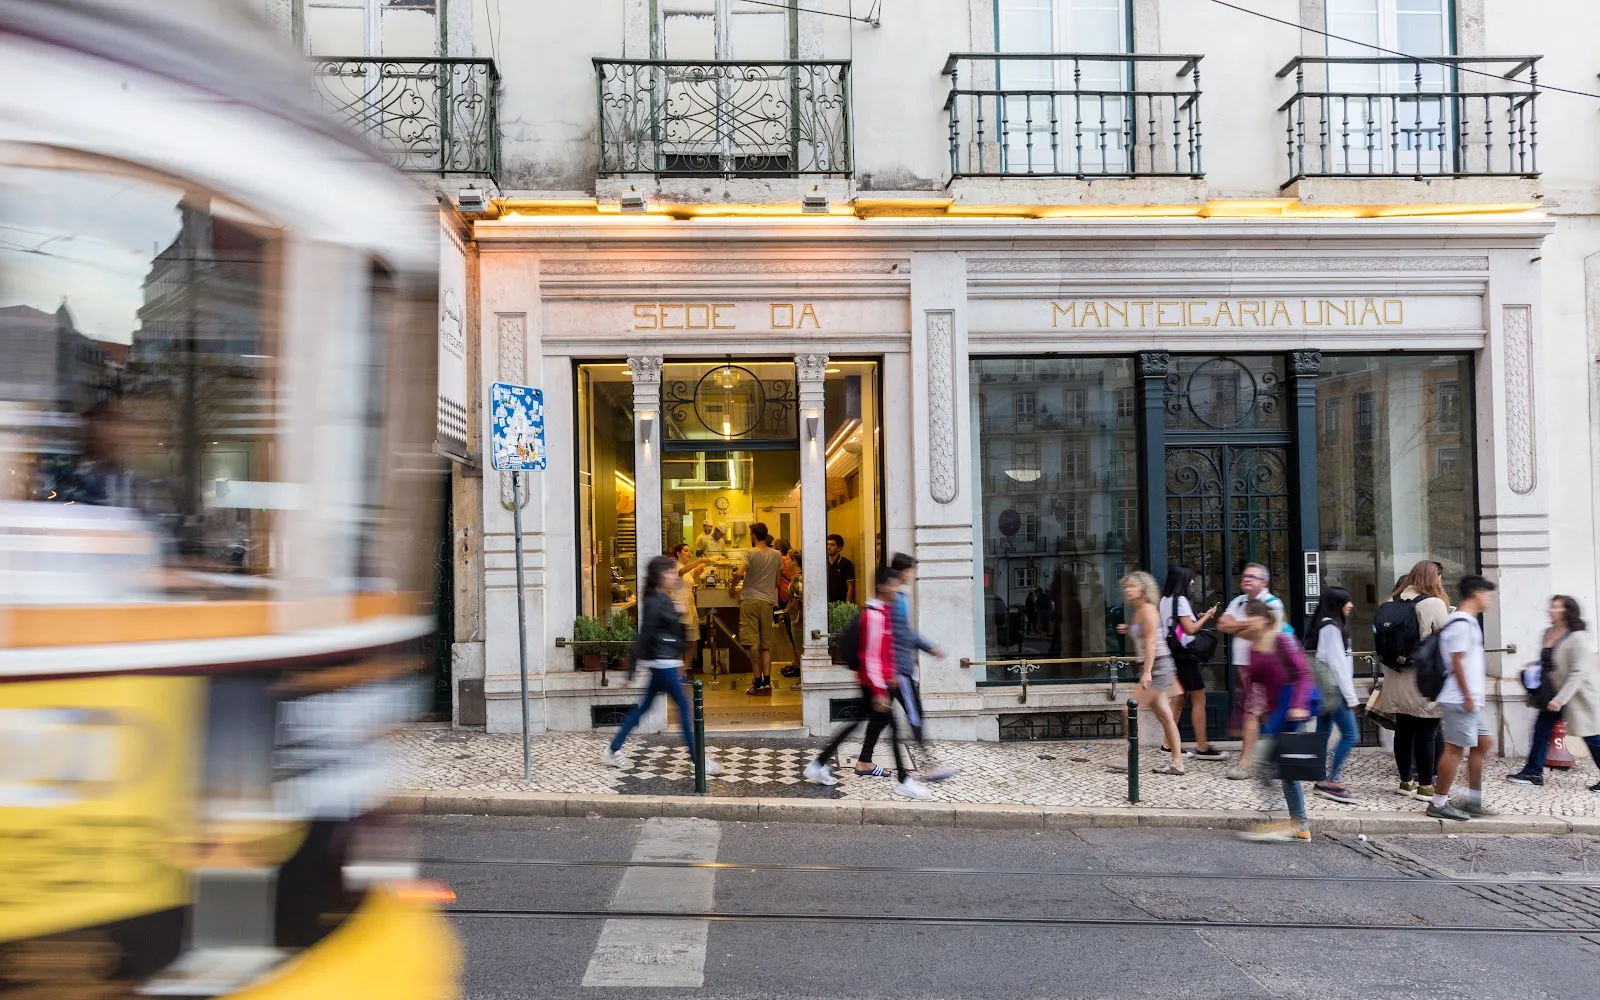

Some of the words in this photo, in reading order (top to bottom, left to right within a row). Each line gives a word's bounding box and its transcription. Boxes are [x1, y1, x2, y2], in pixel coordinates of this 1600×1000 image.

[633, 303, 735, 330] SEDE
[769, 303, 821, 329] DA
[1051, 301, 1293, 328] MANTEIGARIA
[1301, 298, 1403, 326] UNIÃO
